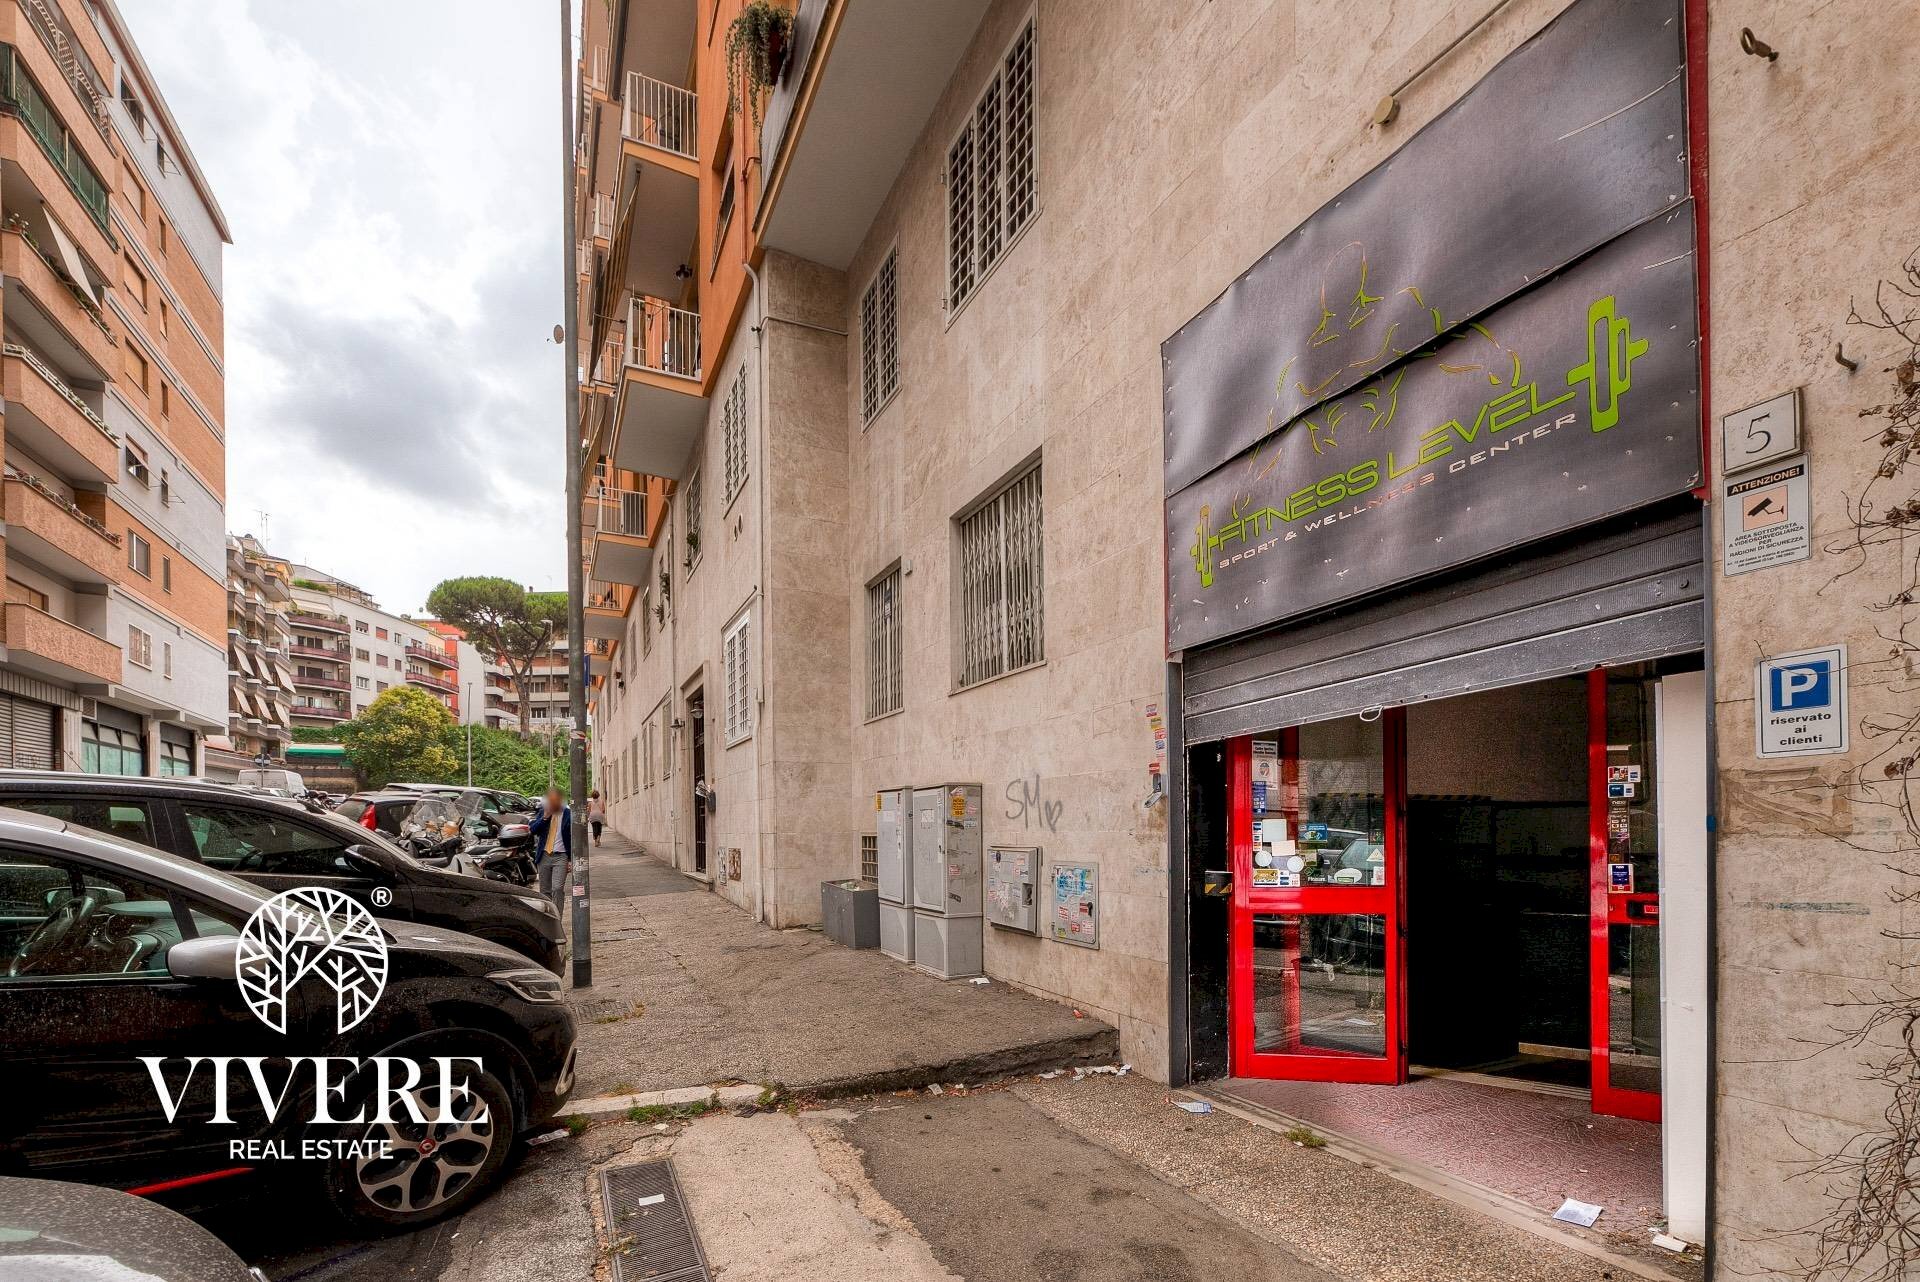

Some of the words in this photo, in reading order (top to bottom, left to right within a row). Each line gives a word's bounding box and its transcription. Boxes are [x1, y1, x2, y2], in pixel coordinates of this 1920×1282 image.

[1745, 412, 1771, 455] 5
[1219, 459, 1380, 551] FITNESS
[1387, 381, 1577, 480] LEVEL
[1219, 537, 1279, 569] SPORT
[1284, 530, 1297, 542] &
[1304, 471, 1435, 532] WELLNESS
[1449, 412, 1577, 474] CENTER
[1731, 468, 1800, 494] ATTENZIONE!
[1734, 534, 1752, 542] AREA
[1753, 522, 1798, 536] SOTTOPOSTA
[1781, 667, 1818, 707] P
[1770, 712, 1832, 726] riservato
[1794, 724, 1807, 734] ai
[1779, 734, 1823, 746] clienti
